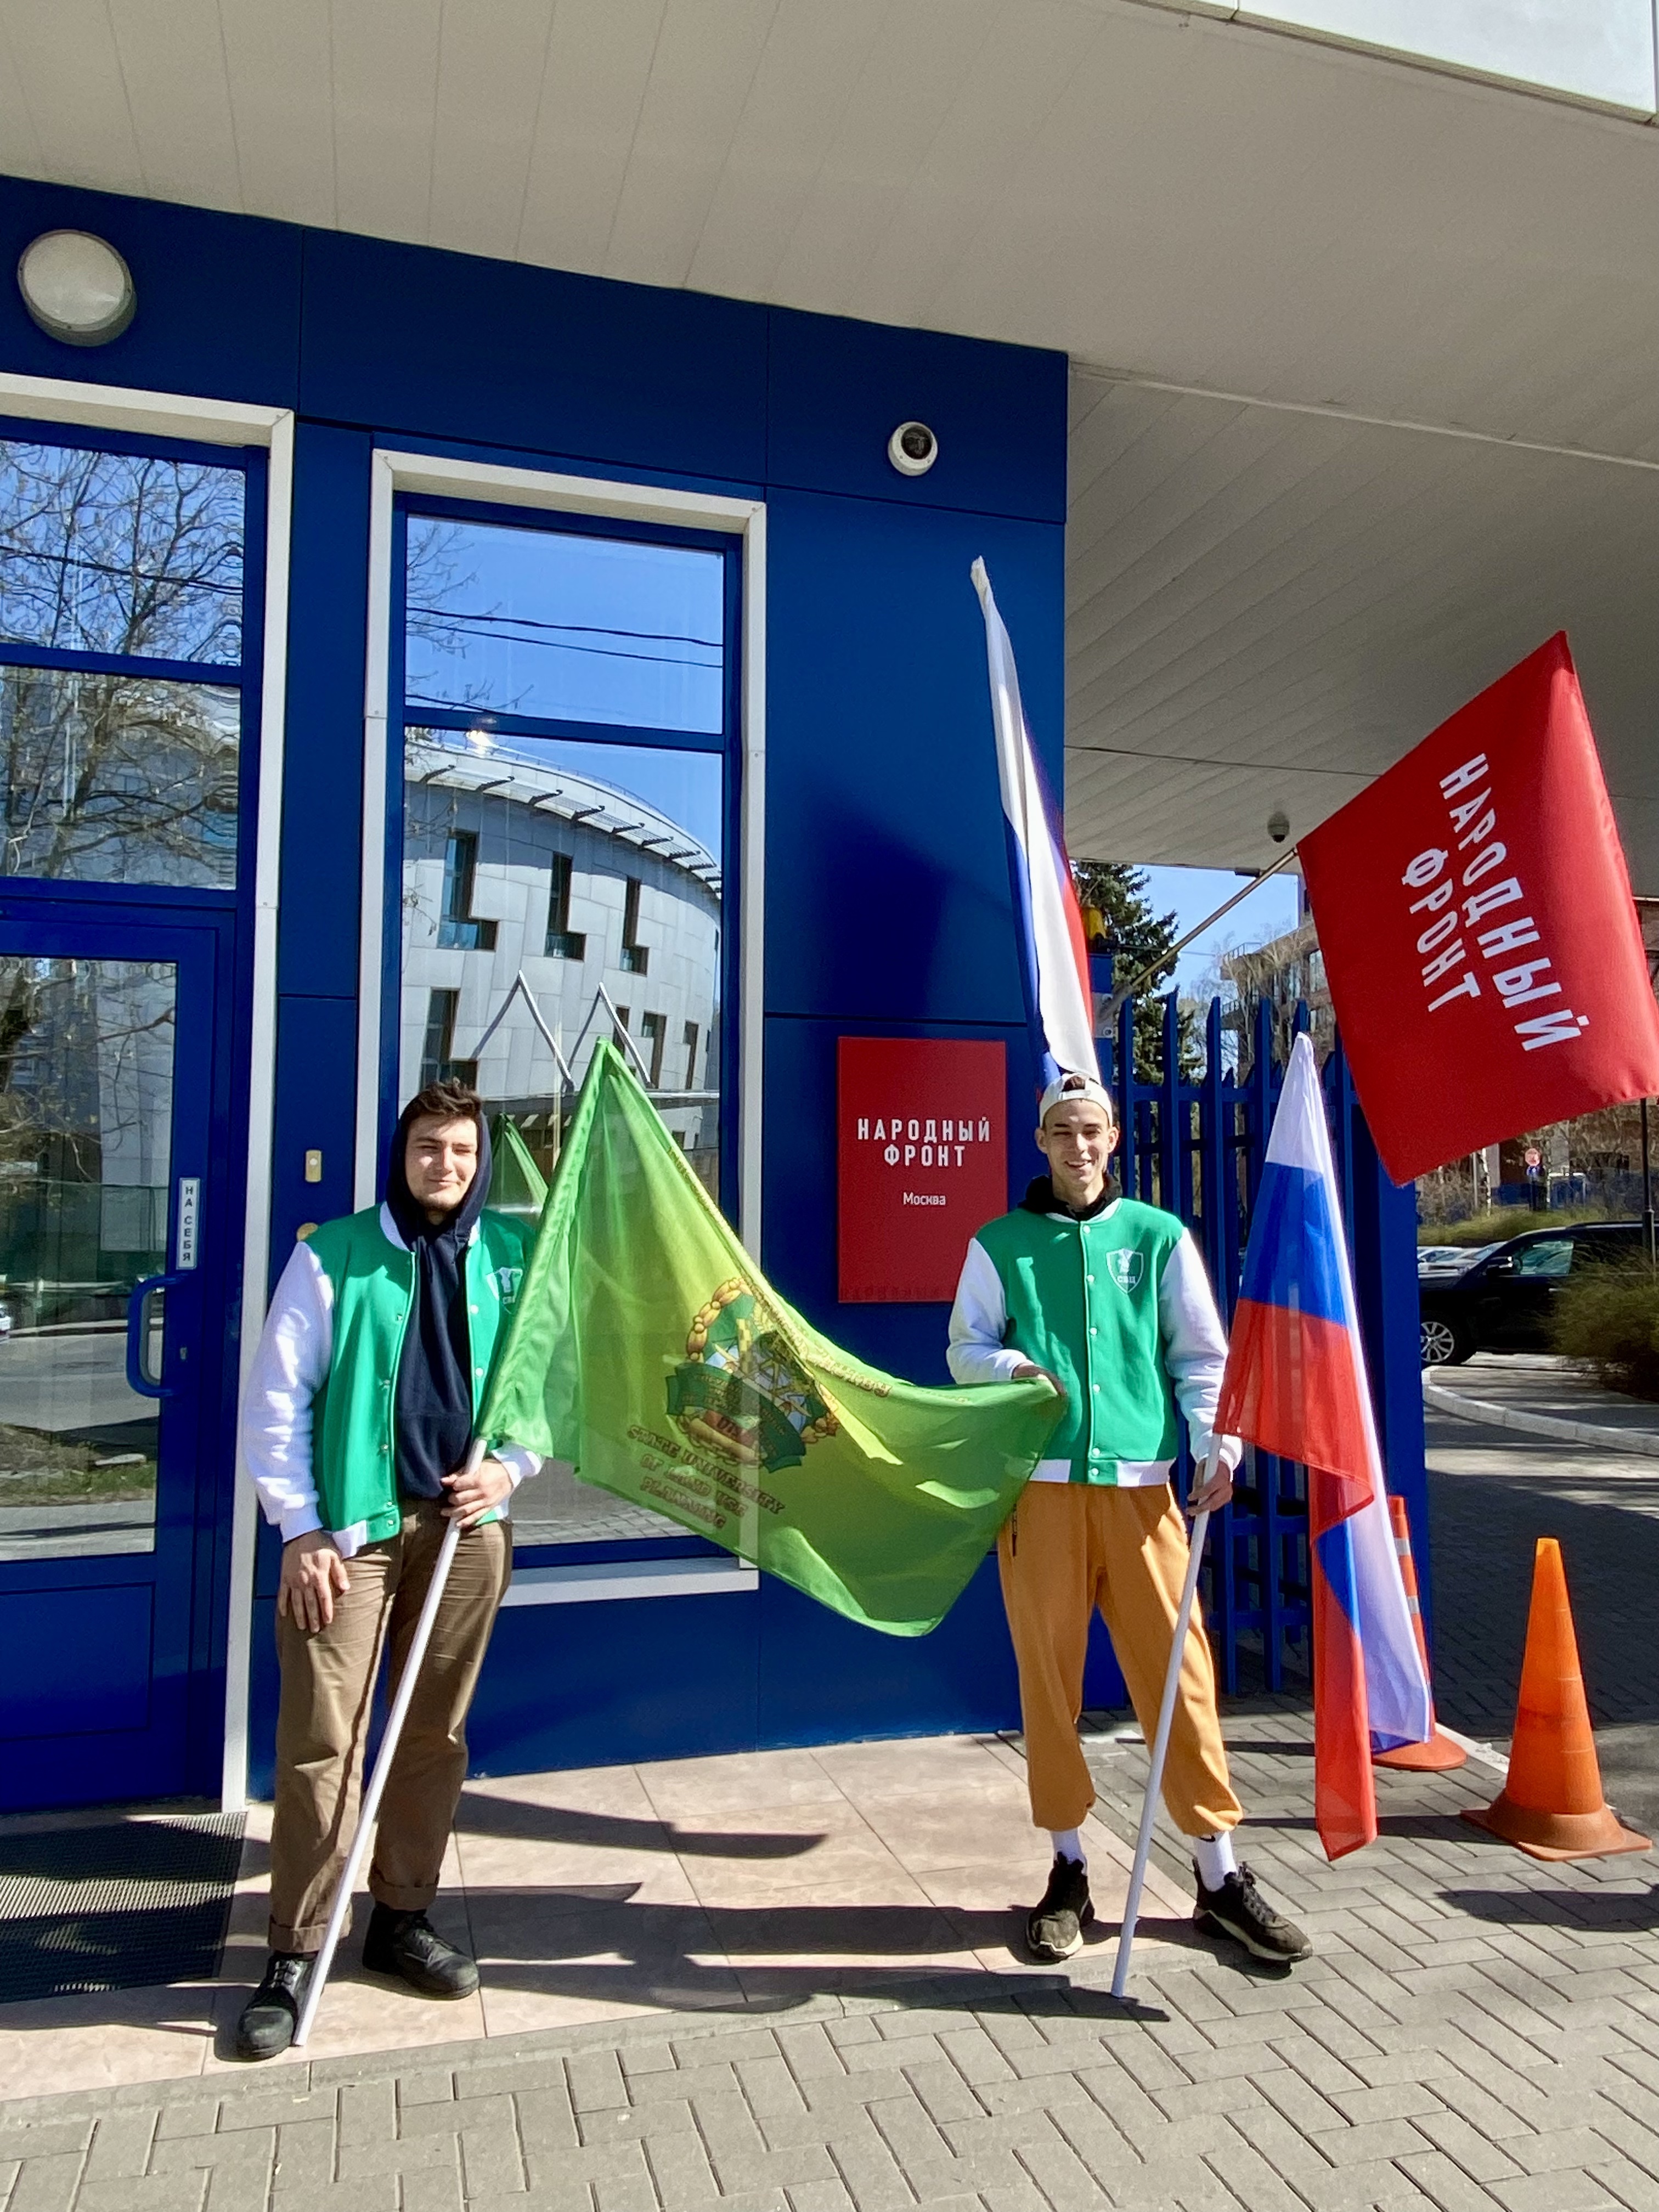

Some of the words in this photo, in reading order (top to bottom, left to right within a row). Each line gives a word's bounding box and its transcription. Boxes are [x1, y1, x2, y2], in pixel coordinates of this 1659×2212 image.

[1439, 753, 1589, 1052] НАРОДНЫЙ
[1401, 847, 1481, 1012] ФРОНТ
[857, 1116, 990, 1143] НАРОДНЫЙ
[883, 1144, 966, 1167] ФРОНТ
[184, 1187, 193, 1207] НА
[902, 1192, 946, 1206] Москва
[183, 1216, 193, 1261] СЕБЯ
[627, 1425, 681, 1458] STATE
[682, 1449, 786, 1514] UNIVERSITY
